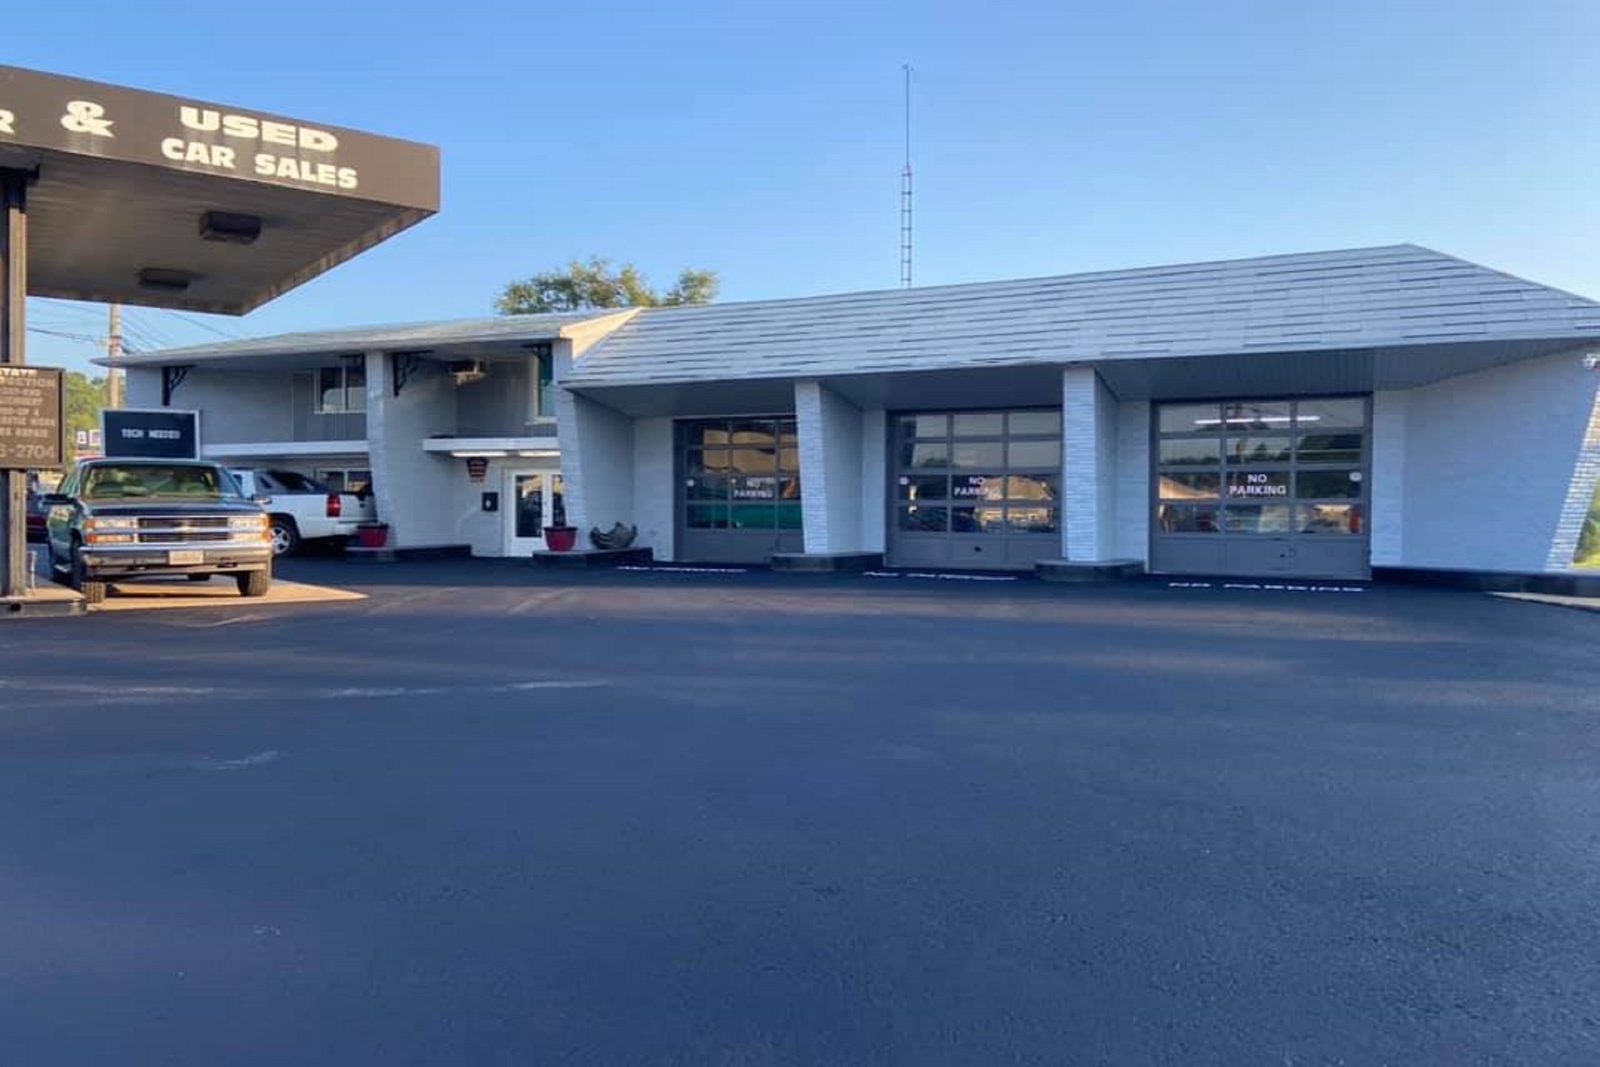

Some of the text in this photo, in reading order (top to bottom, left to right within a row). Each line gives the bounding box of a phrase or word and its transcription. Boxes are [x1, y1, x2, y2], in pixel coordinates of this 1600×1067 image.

[61, 100, 115, 138] &
[180, 106, 339, 152] USED
[161, 138, 359, 189] CAR SALES
[968, 476, 986, 486] NO
[1247, 474, 1268, 484] NO
[1229, 485, 1287, 496] PARKING
